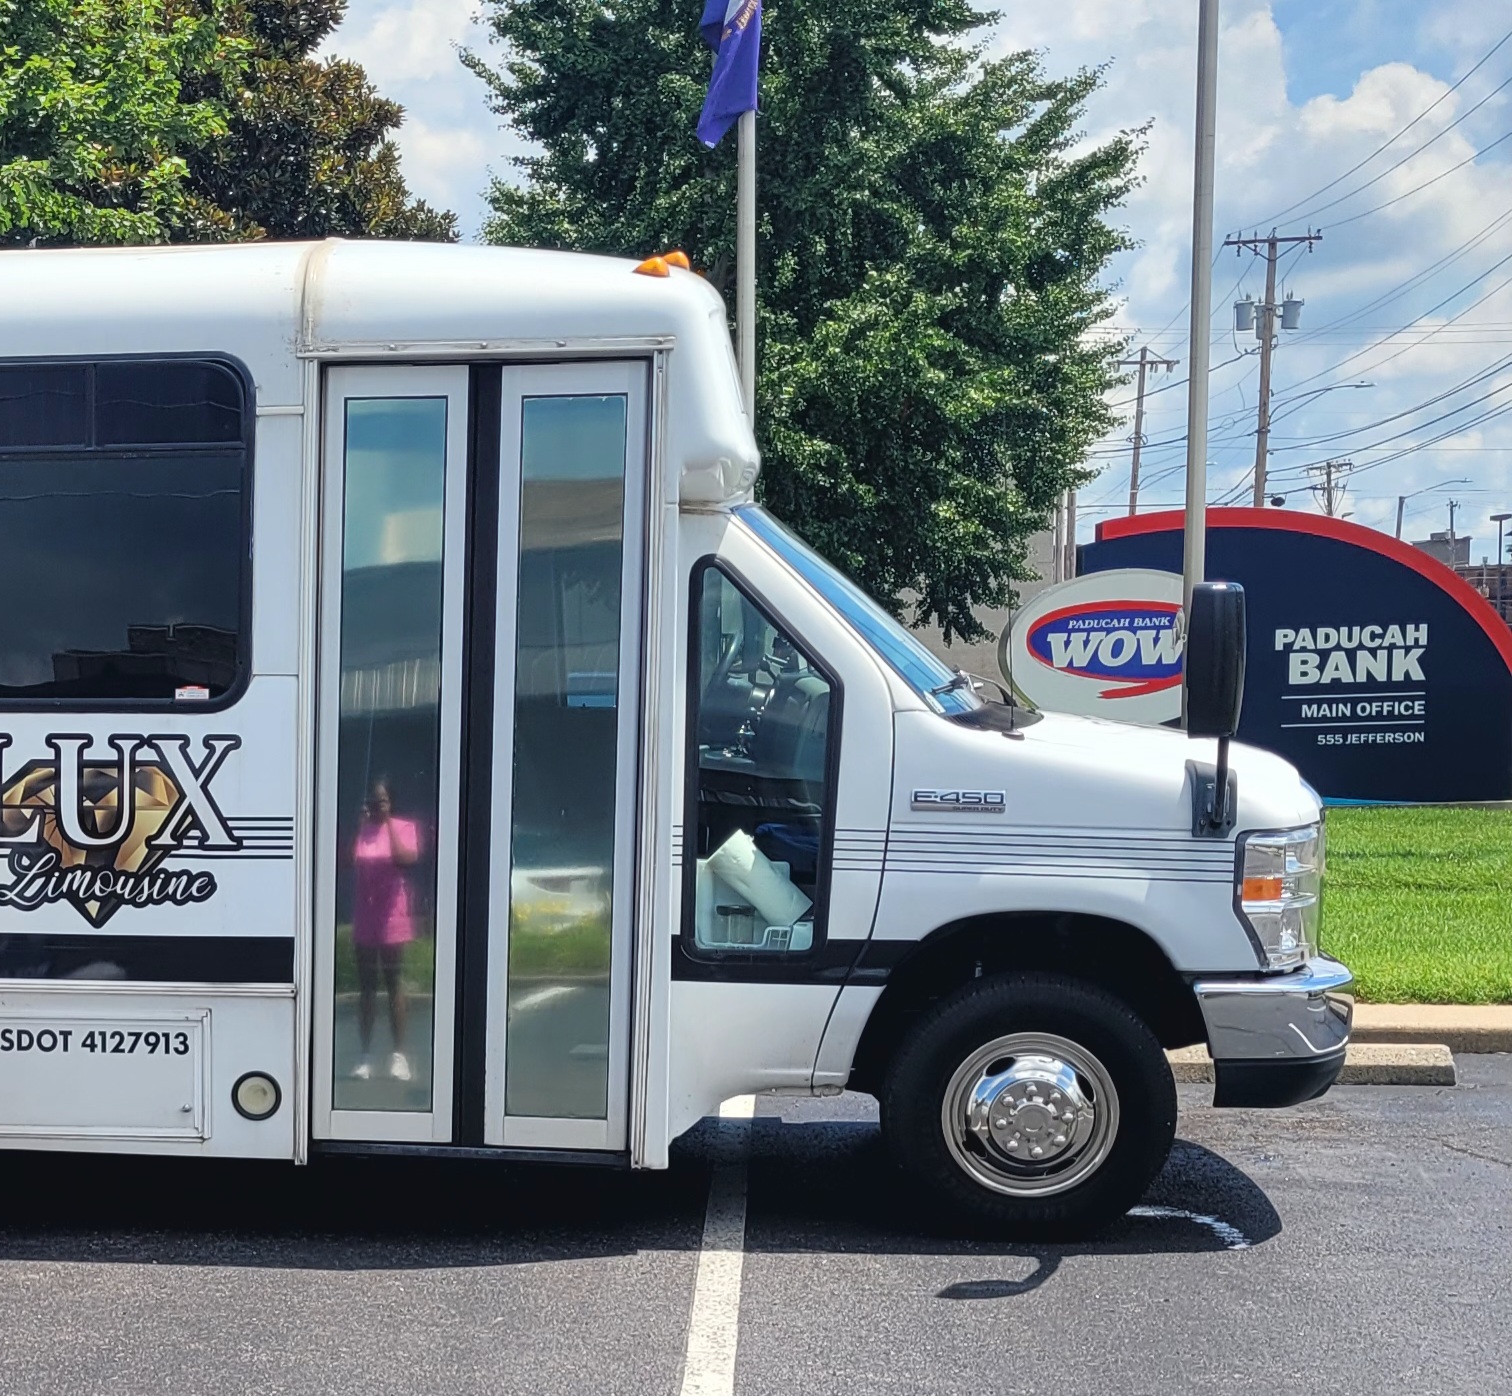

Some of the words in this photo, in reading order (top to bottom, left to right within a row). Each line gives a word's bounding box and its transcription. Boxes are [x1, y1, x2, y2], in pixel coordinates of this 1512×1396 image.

[1068, 618, 1130, 629] PADUCAH
[1133, 616, 1171, 627] BANK
[1274, 623, 1428, 651] PADUCAH
[1046, 629, 1183, 668] WOW
[1288, 647, 1426, 685] BANK
[1301, 702, 1351, 718] MAIN
[1356, 701, 1426, 717] OFFICE
[1317, 734, 1343, 745] 555
[1345, 731, 1425, 744] JEFFERSON
[913, 790, 1005, 805] E-450
[81, 1030, 190, 1056] 4127913
